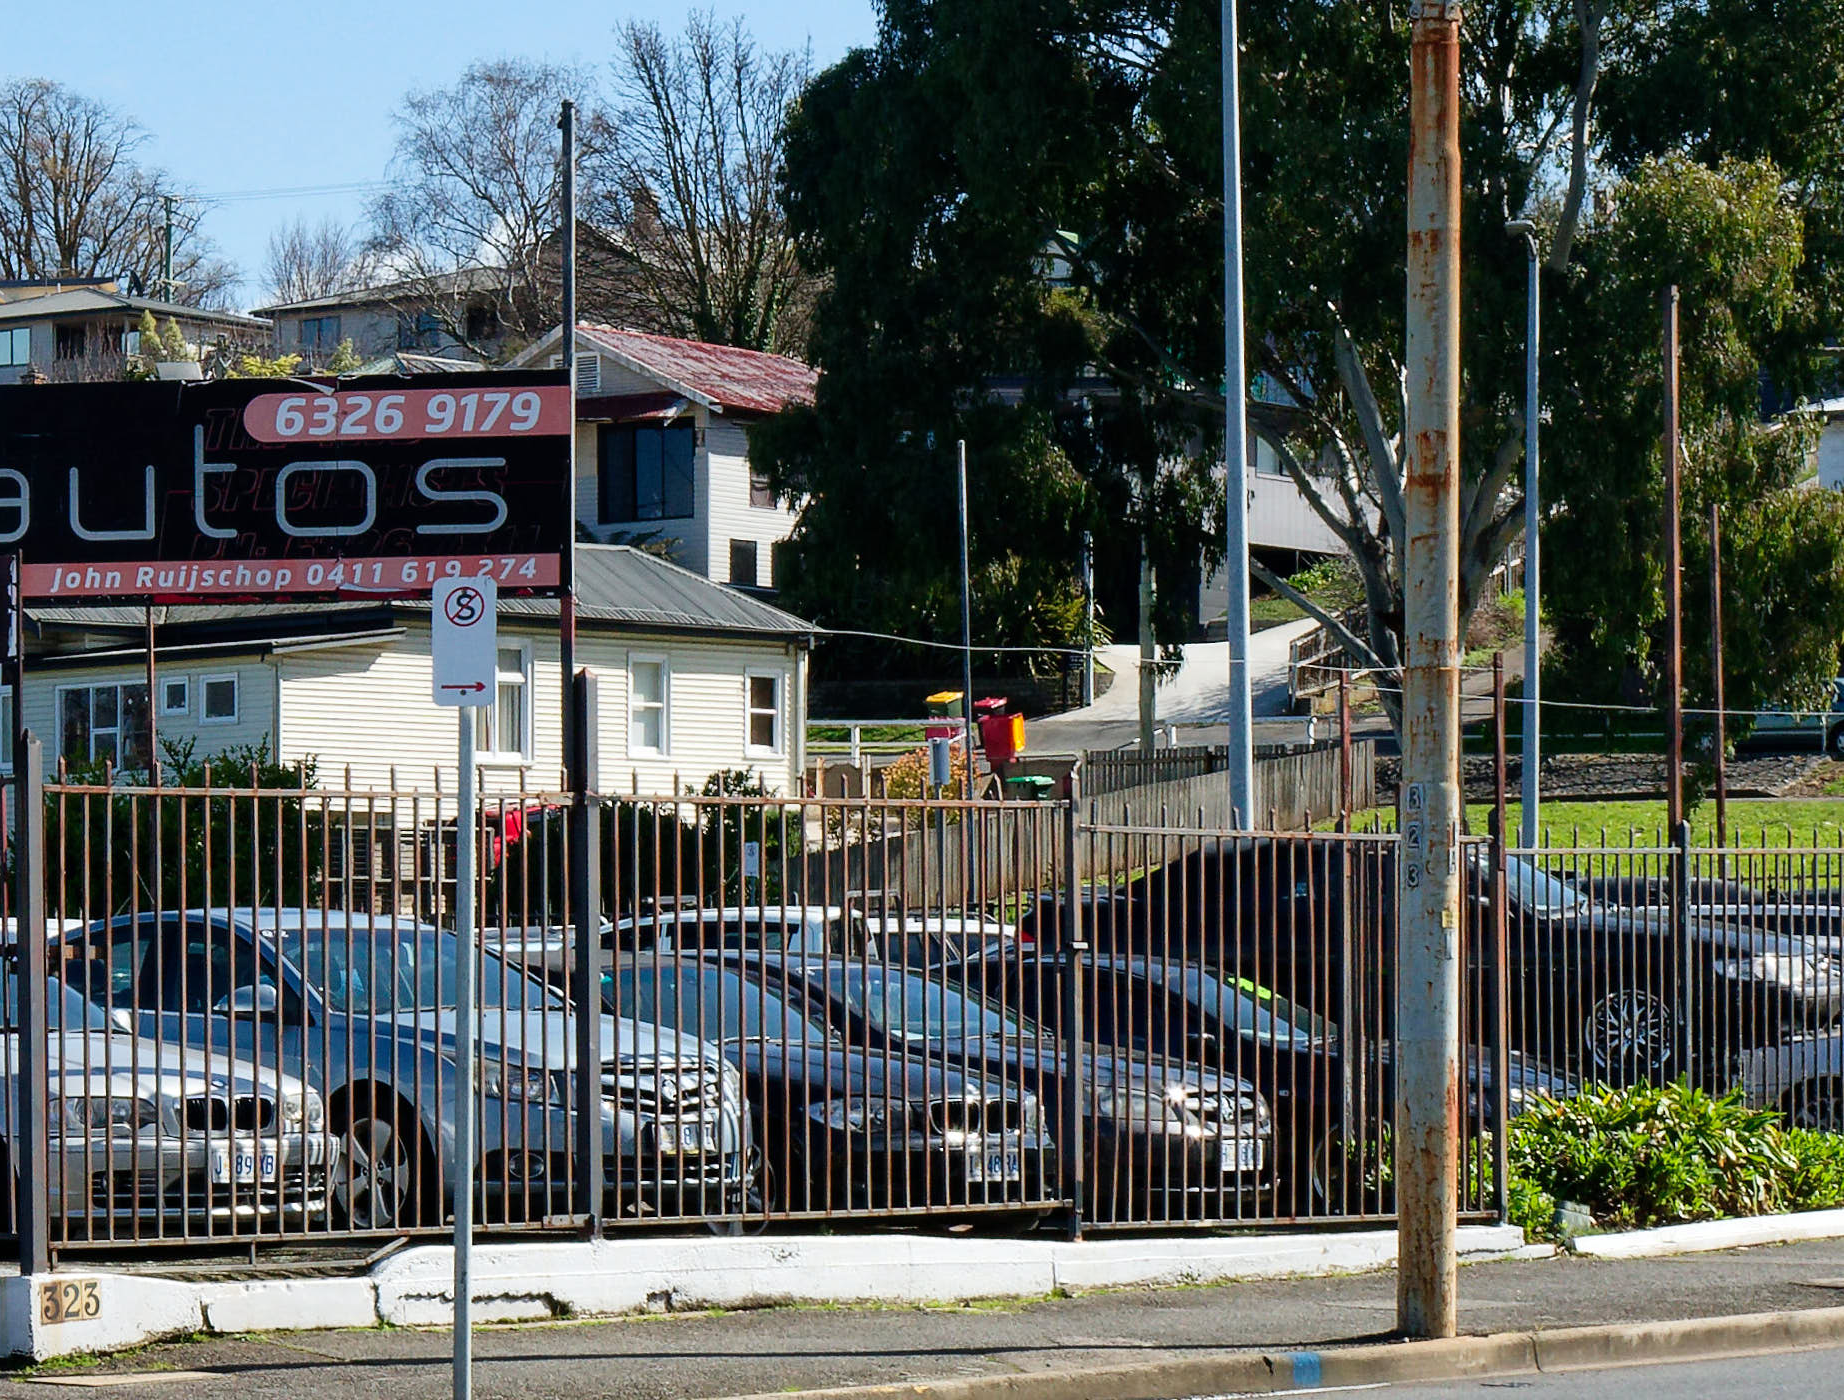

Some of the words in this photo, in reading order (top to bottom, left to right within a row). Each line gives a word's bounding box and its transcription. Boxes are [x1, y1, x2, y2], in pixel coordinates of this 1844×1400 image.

[274, 395, 406, 437] 6326
[424, 391, 542, 433] 9179
[50, 566, 122, 594] John
[135, 562, 292, 592] Ruijschop
[306, 560, 383, 585] 0411
[401, 557, 461, 583] 619
[478, 556, 538, 580] 274
[235, 1154, 253, 1176] 89
[43, 1282, 100, 1321] 323
